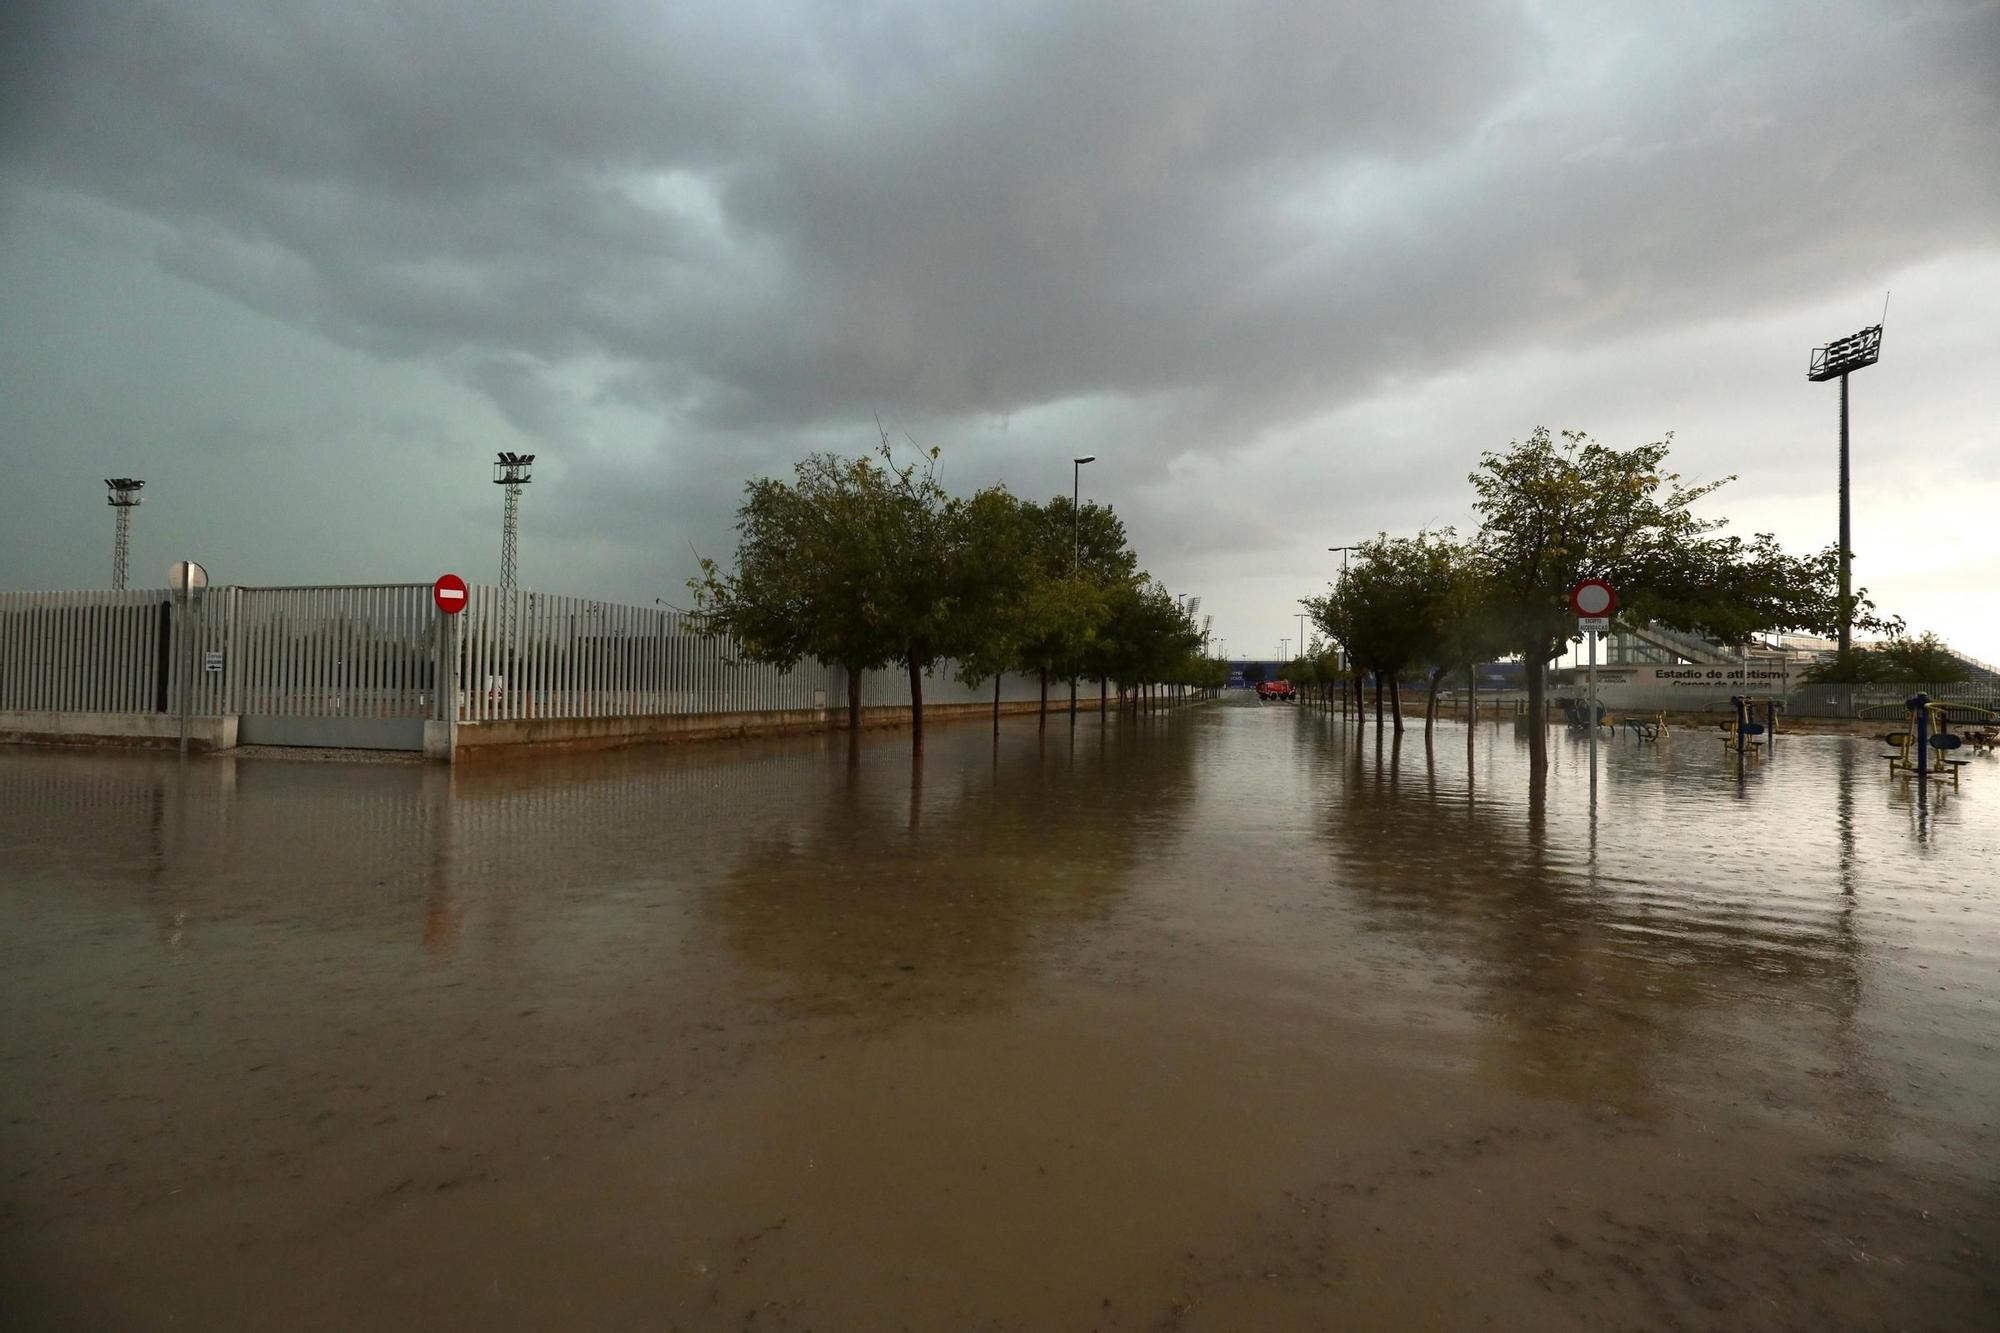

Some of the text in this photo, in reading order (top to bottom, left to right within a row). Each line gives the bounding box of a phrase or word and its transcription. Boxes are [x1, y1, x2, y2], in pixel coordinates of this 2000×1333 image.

[1656, 669, 1789, 679] Estadio de atletismo
